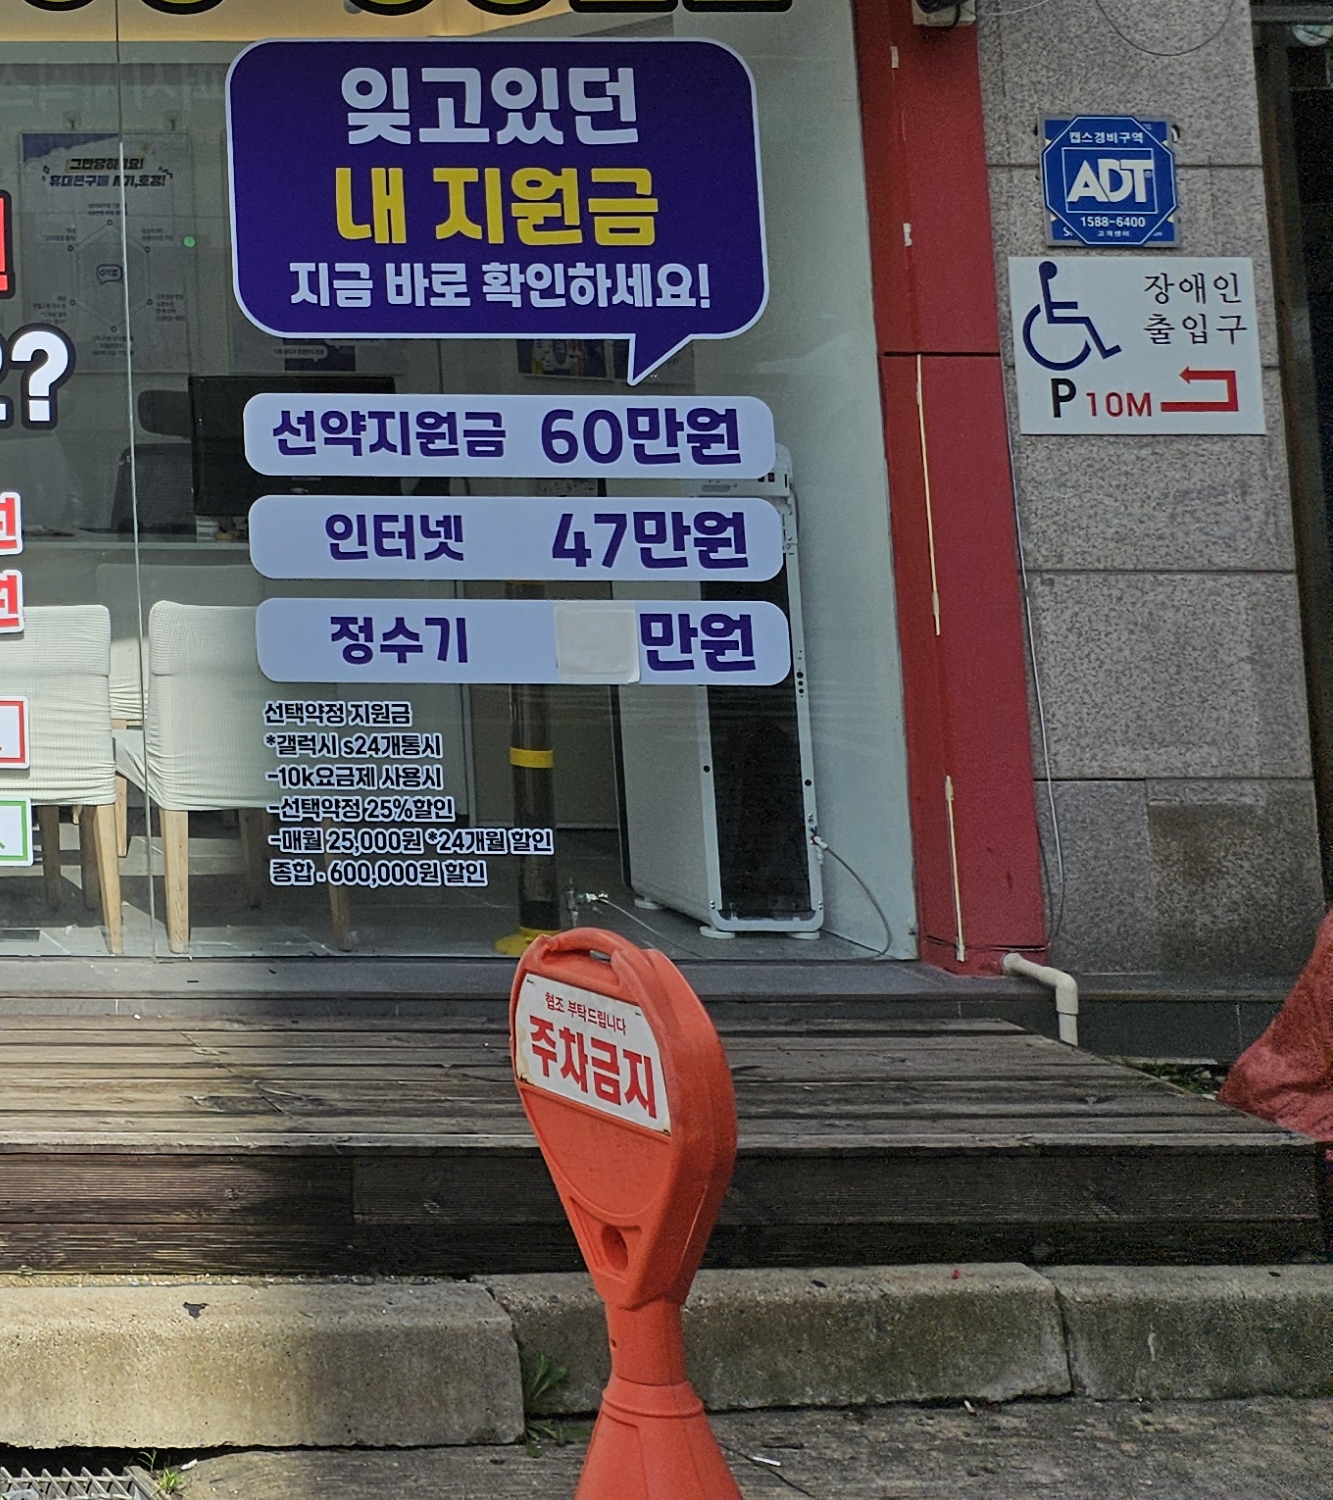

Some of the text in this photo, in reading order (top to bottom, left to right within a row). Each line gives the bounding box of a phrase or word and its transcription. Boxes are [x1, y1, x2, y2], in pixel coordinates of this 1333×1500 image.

[340, 67, 639, 145] 잊고있던
[1066, 158, 1154, 203] ADT
[334, 167, 660, 246] 내 지원금
[1080, 216, 1146, 228] 1588-6400
[289, 263, 711, 310] 지금 바로 확인하세요!
[1143, 273, 1242, 305] 장애인
[1143, 313, 1248, 346] 출입구
[1050, 377, 1152, 418] P 10M
[272, 408, 742, 465] 선약지원금 60만원
[324, 511, 749, 569] 인터넷 47만원
[329, 616, 469, 664] 정수기
[263, 701, 413, 726] 선택약정 지원금
[381, 766, 443, 788] 사용시
[366, 797, 454, 820] 25%할인
[327, 829, 423, 856] 25,000원
[510, 829, 553, 852] 할인
[443, 861, 487, 884] 할인
[545, 991, 627, 1036] 협조 부탁드립니다
[529, 1015, 657, 1120] 주차금지
